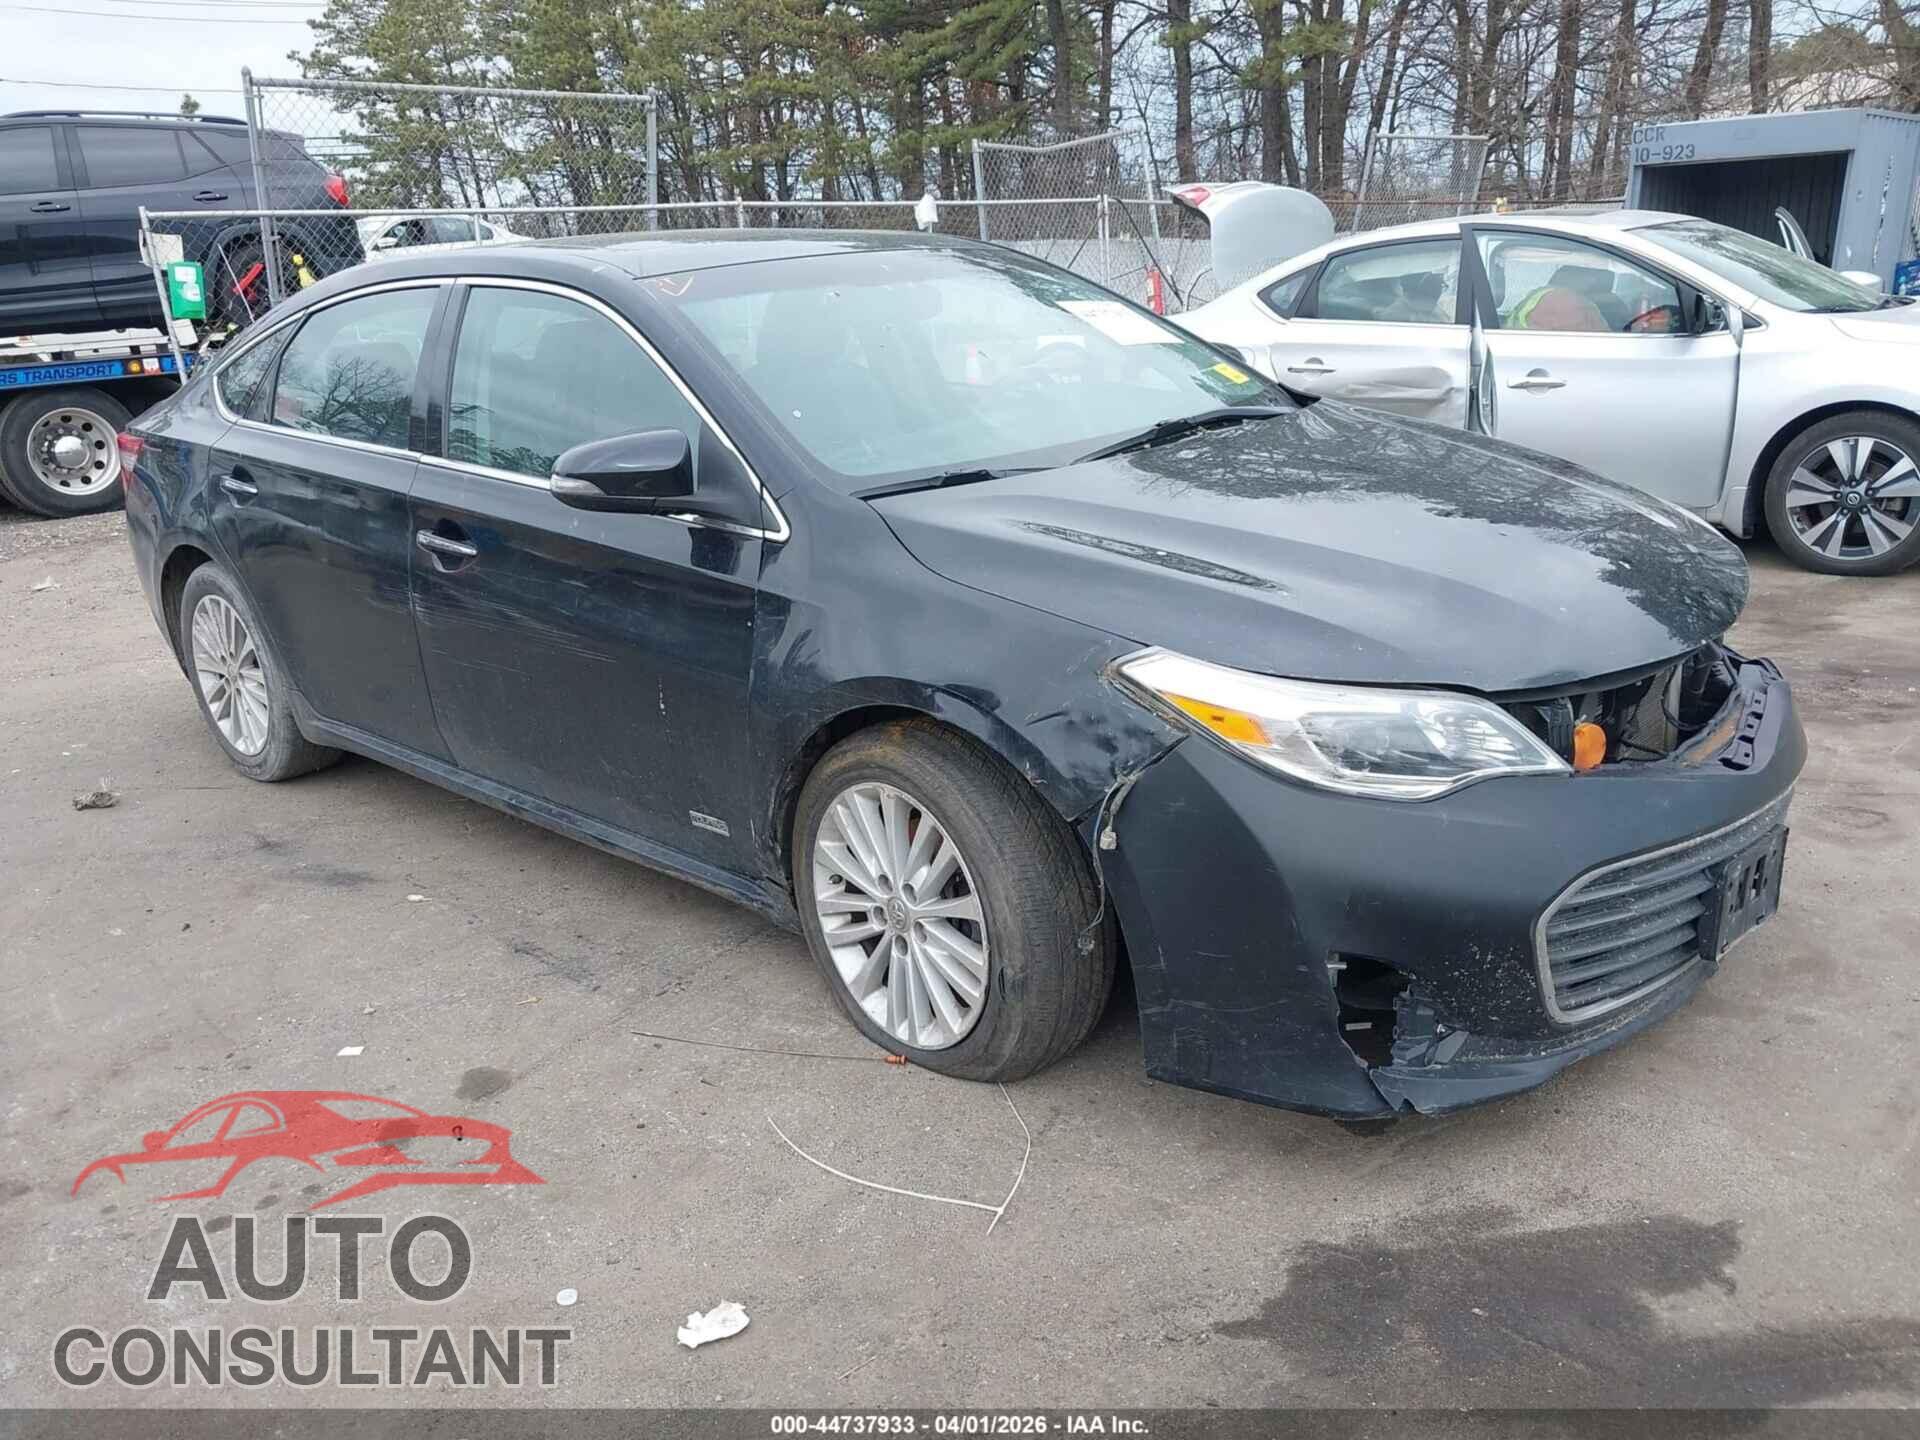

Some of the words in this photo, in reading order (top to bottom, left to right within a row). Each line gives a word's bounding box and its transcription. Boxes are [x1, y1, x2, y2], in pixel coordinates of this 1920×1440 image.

[1633, 126, 1665, 144] CCR
[1634, 143, 1696, 162] 10-923
[24, 363, 114, 384] TRANSPORT
